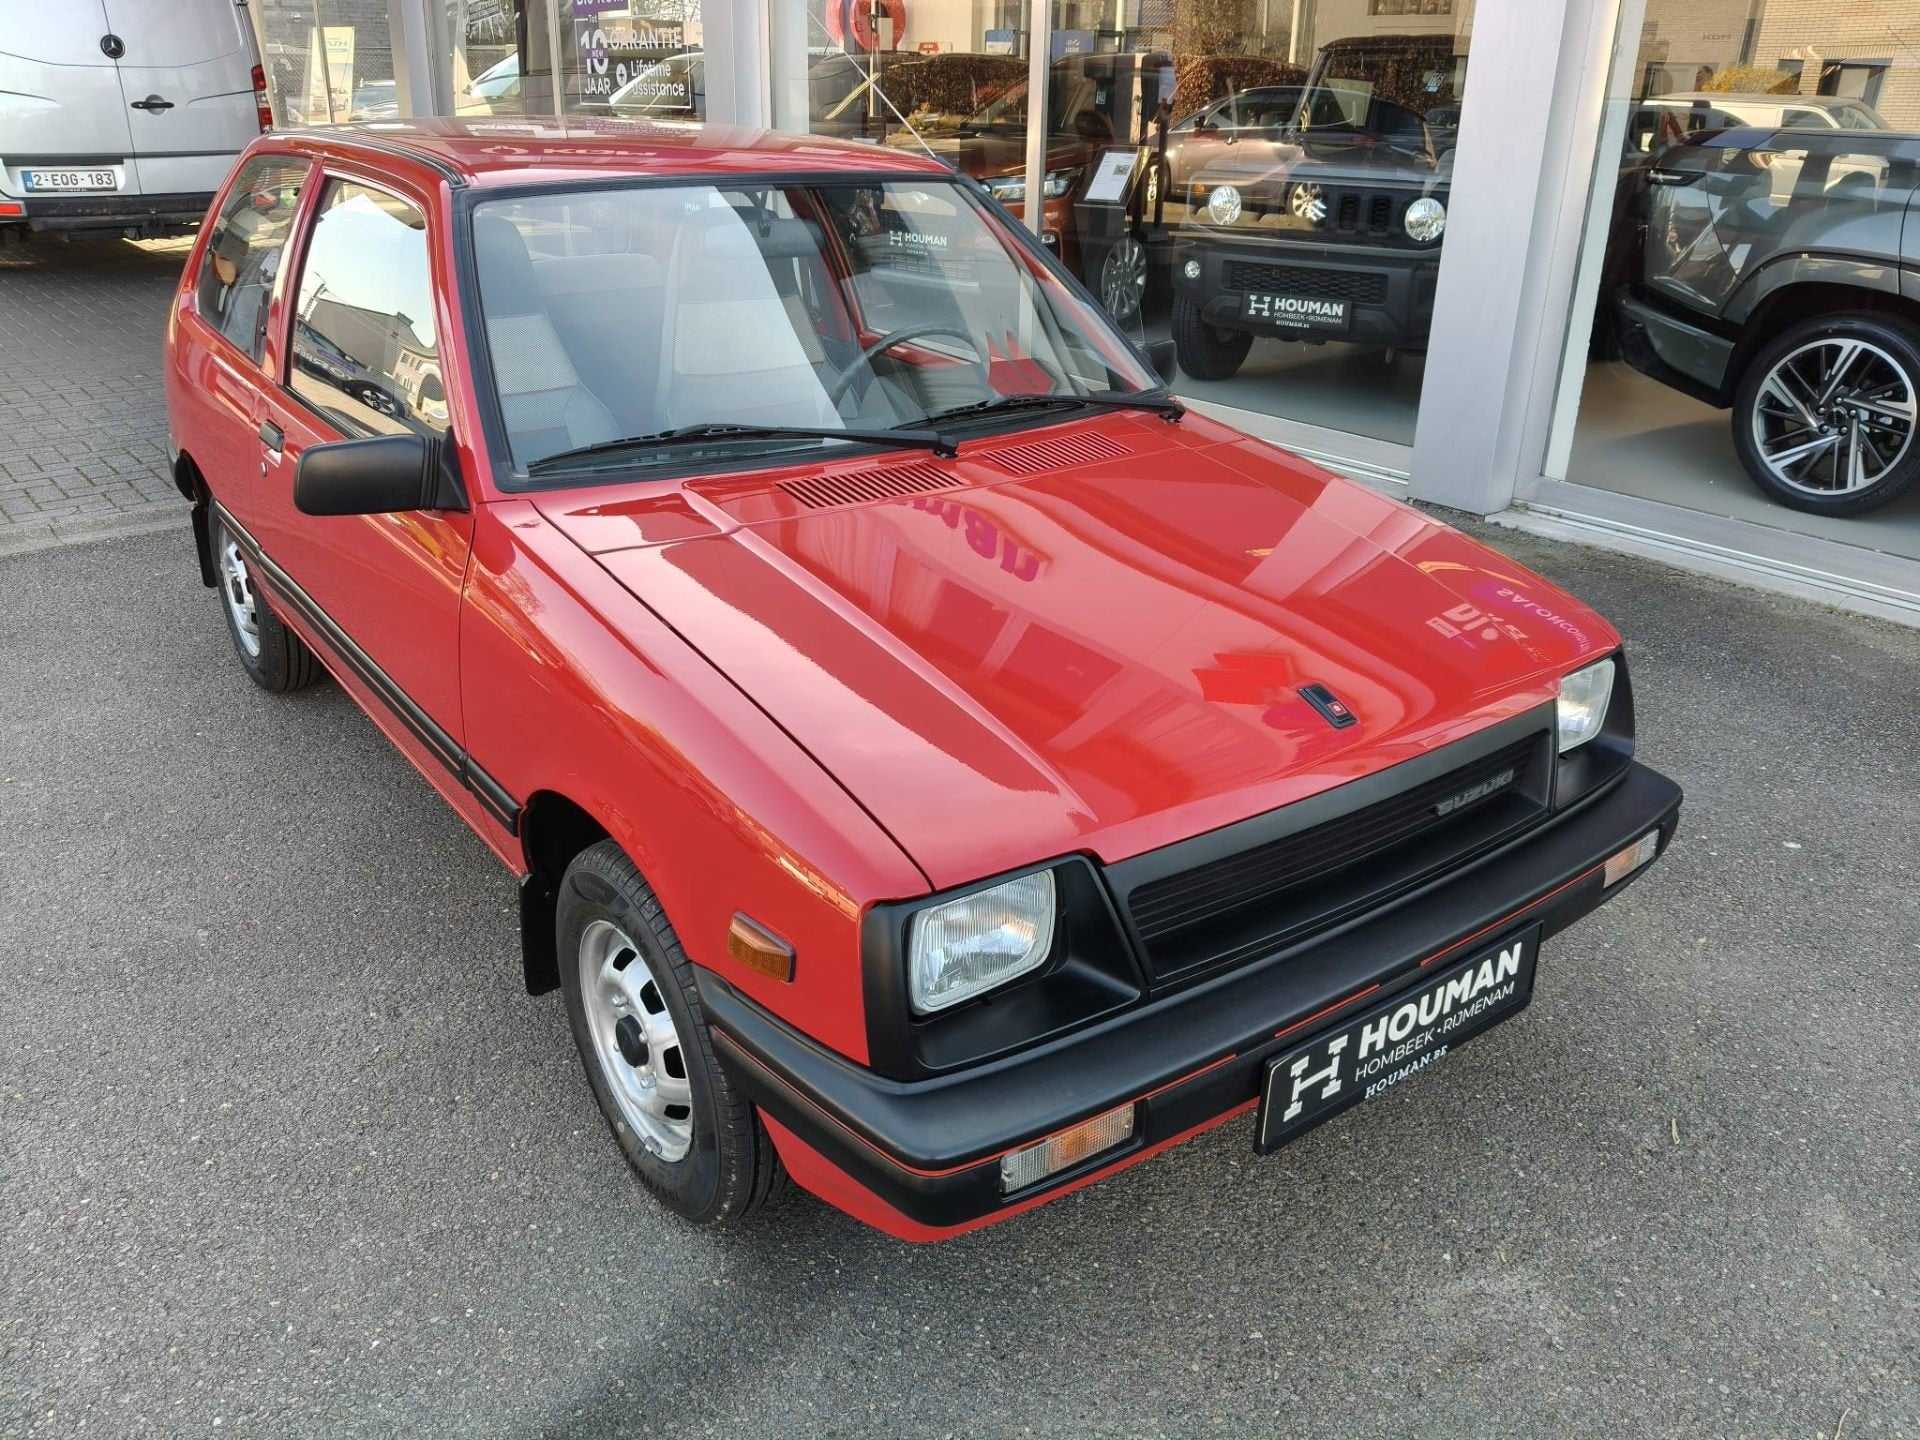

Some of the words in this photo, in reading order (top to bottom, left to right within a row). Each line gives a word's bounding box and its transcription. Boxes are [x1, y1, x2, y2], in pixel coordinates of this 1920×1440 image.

[610, 27, 683, 50] GARANTIE
[630, 59, 672, 78] Lifetime
[585, 78, 612, 95] JAAR
[33, 173, 113, 187] 2-EQG-183
[904, 232, 948, 247] HOUMAN
[1274, 297, 1344, 317] HOUMAN
[1436, 767, 1514, 817] SUZUKI
[1358, 942, 1522, 1060] HOUMAN
[1354, 1026, 1435, 1082] HOMBEEK
[1441, 981, 1515, 1034] RIJMENAM
[1364, 1044, 1449, 1100] HOUMAN.BE
